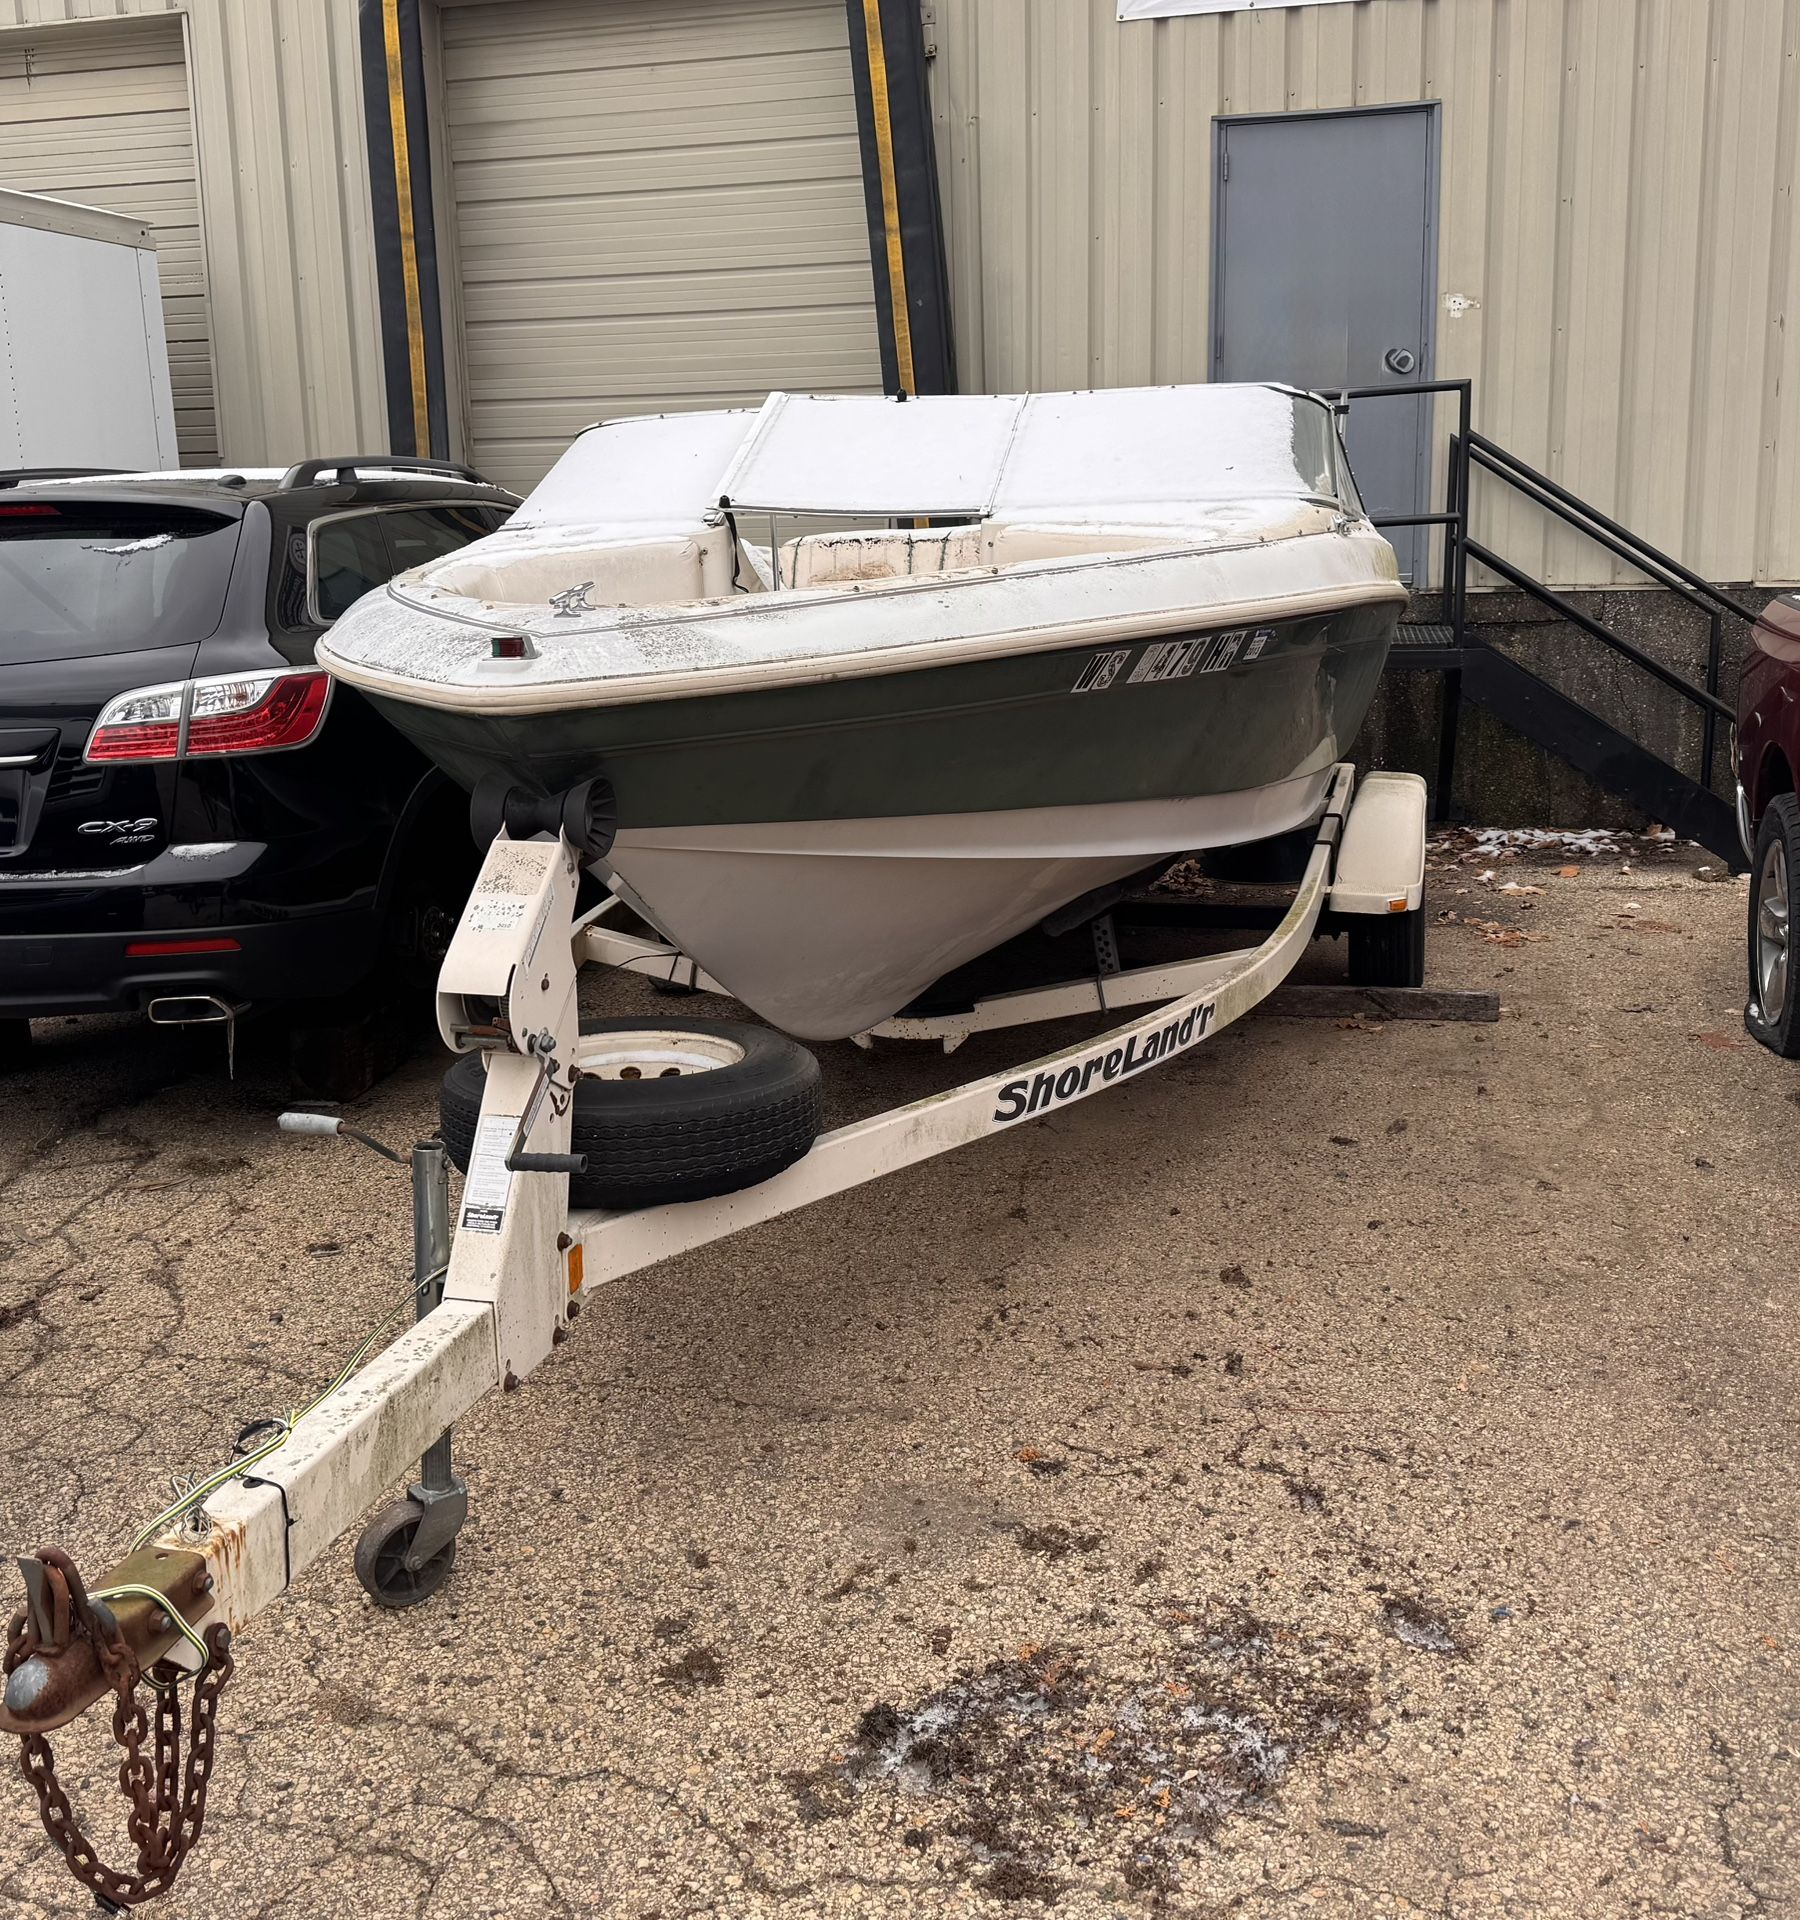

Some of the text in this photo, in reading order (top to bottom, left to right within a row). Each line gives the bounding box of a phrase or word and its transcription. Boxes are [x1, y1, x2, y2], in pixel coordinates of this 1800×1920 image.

[1073, 650, 1128, 690] WS
[77, 817, 158, 834] CX-9
[109, 834, 155, 846] AWD
[992, 1001, 1216, 1123] ShoreLand'r
